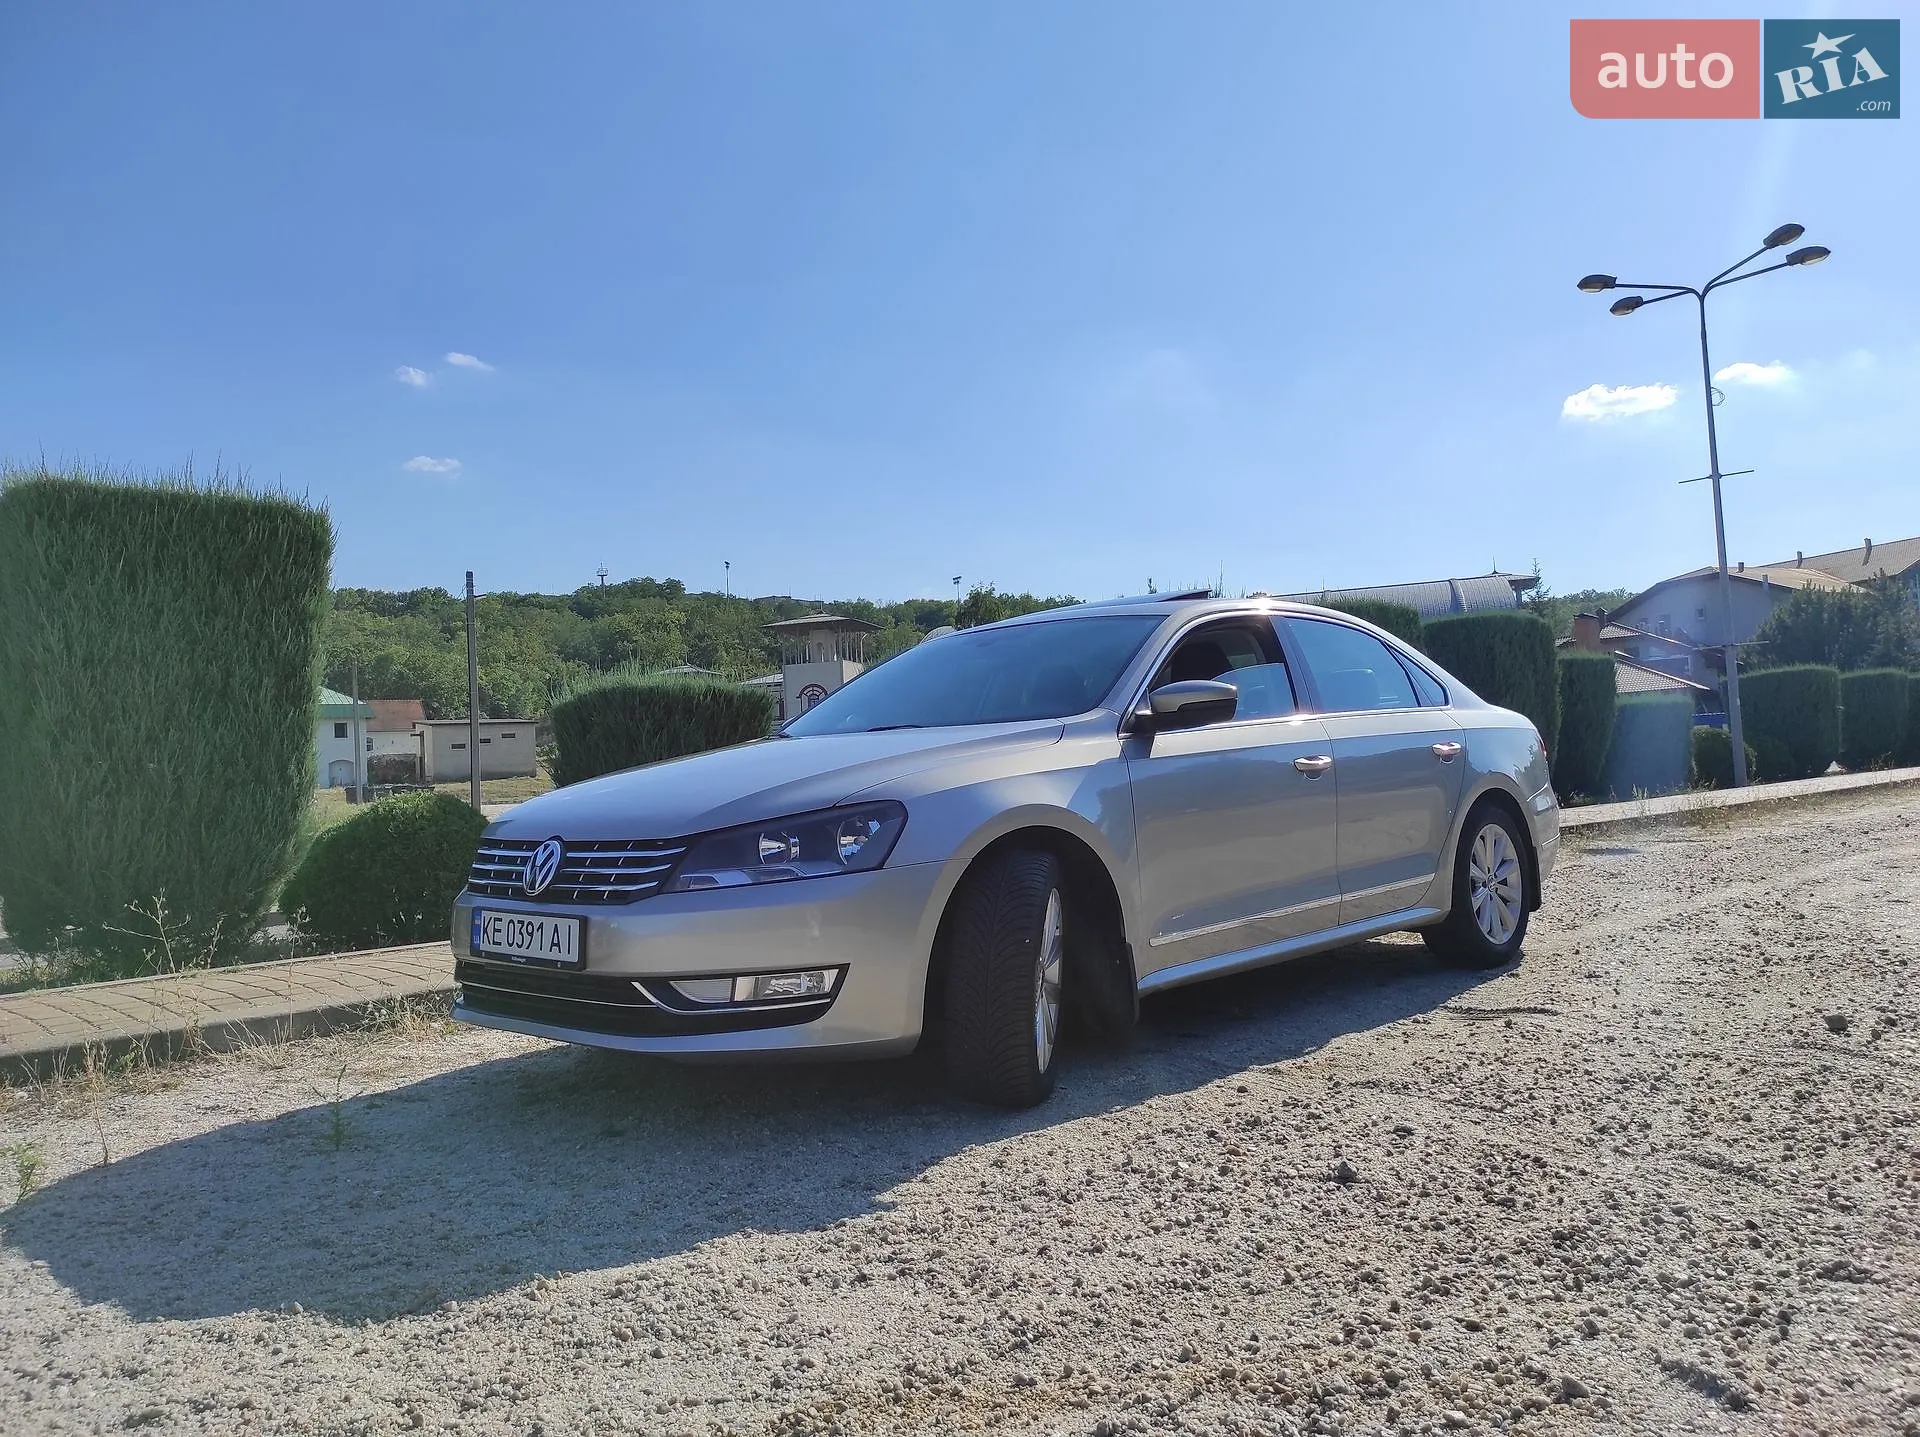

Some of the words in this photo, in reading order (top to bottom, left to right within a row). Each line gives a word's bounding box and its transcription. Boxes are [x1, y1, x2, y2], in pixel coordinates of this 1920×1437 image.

[482, 916, 502, 946] KE
[506, 919, 544, 951] 0391
[550, 924, 571, 955] AI
